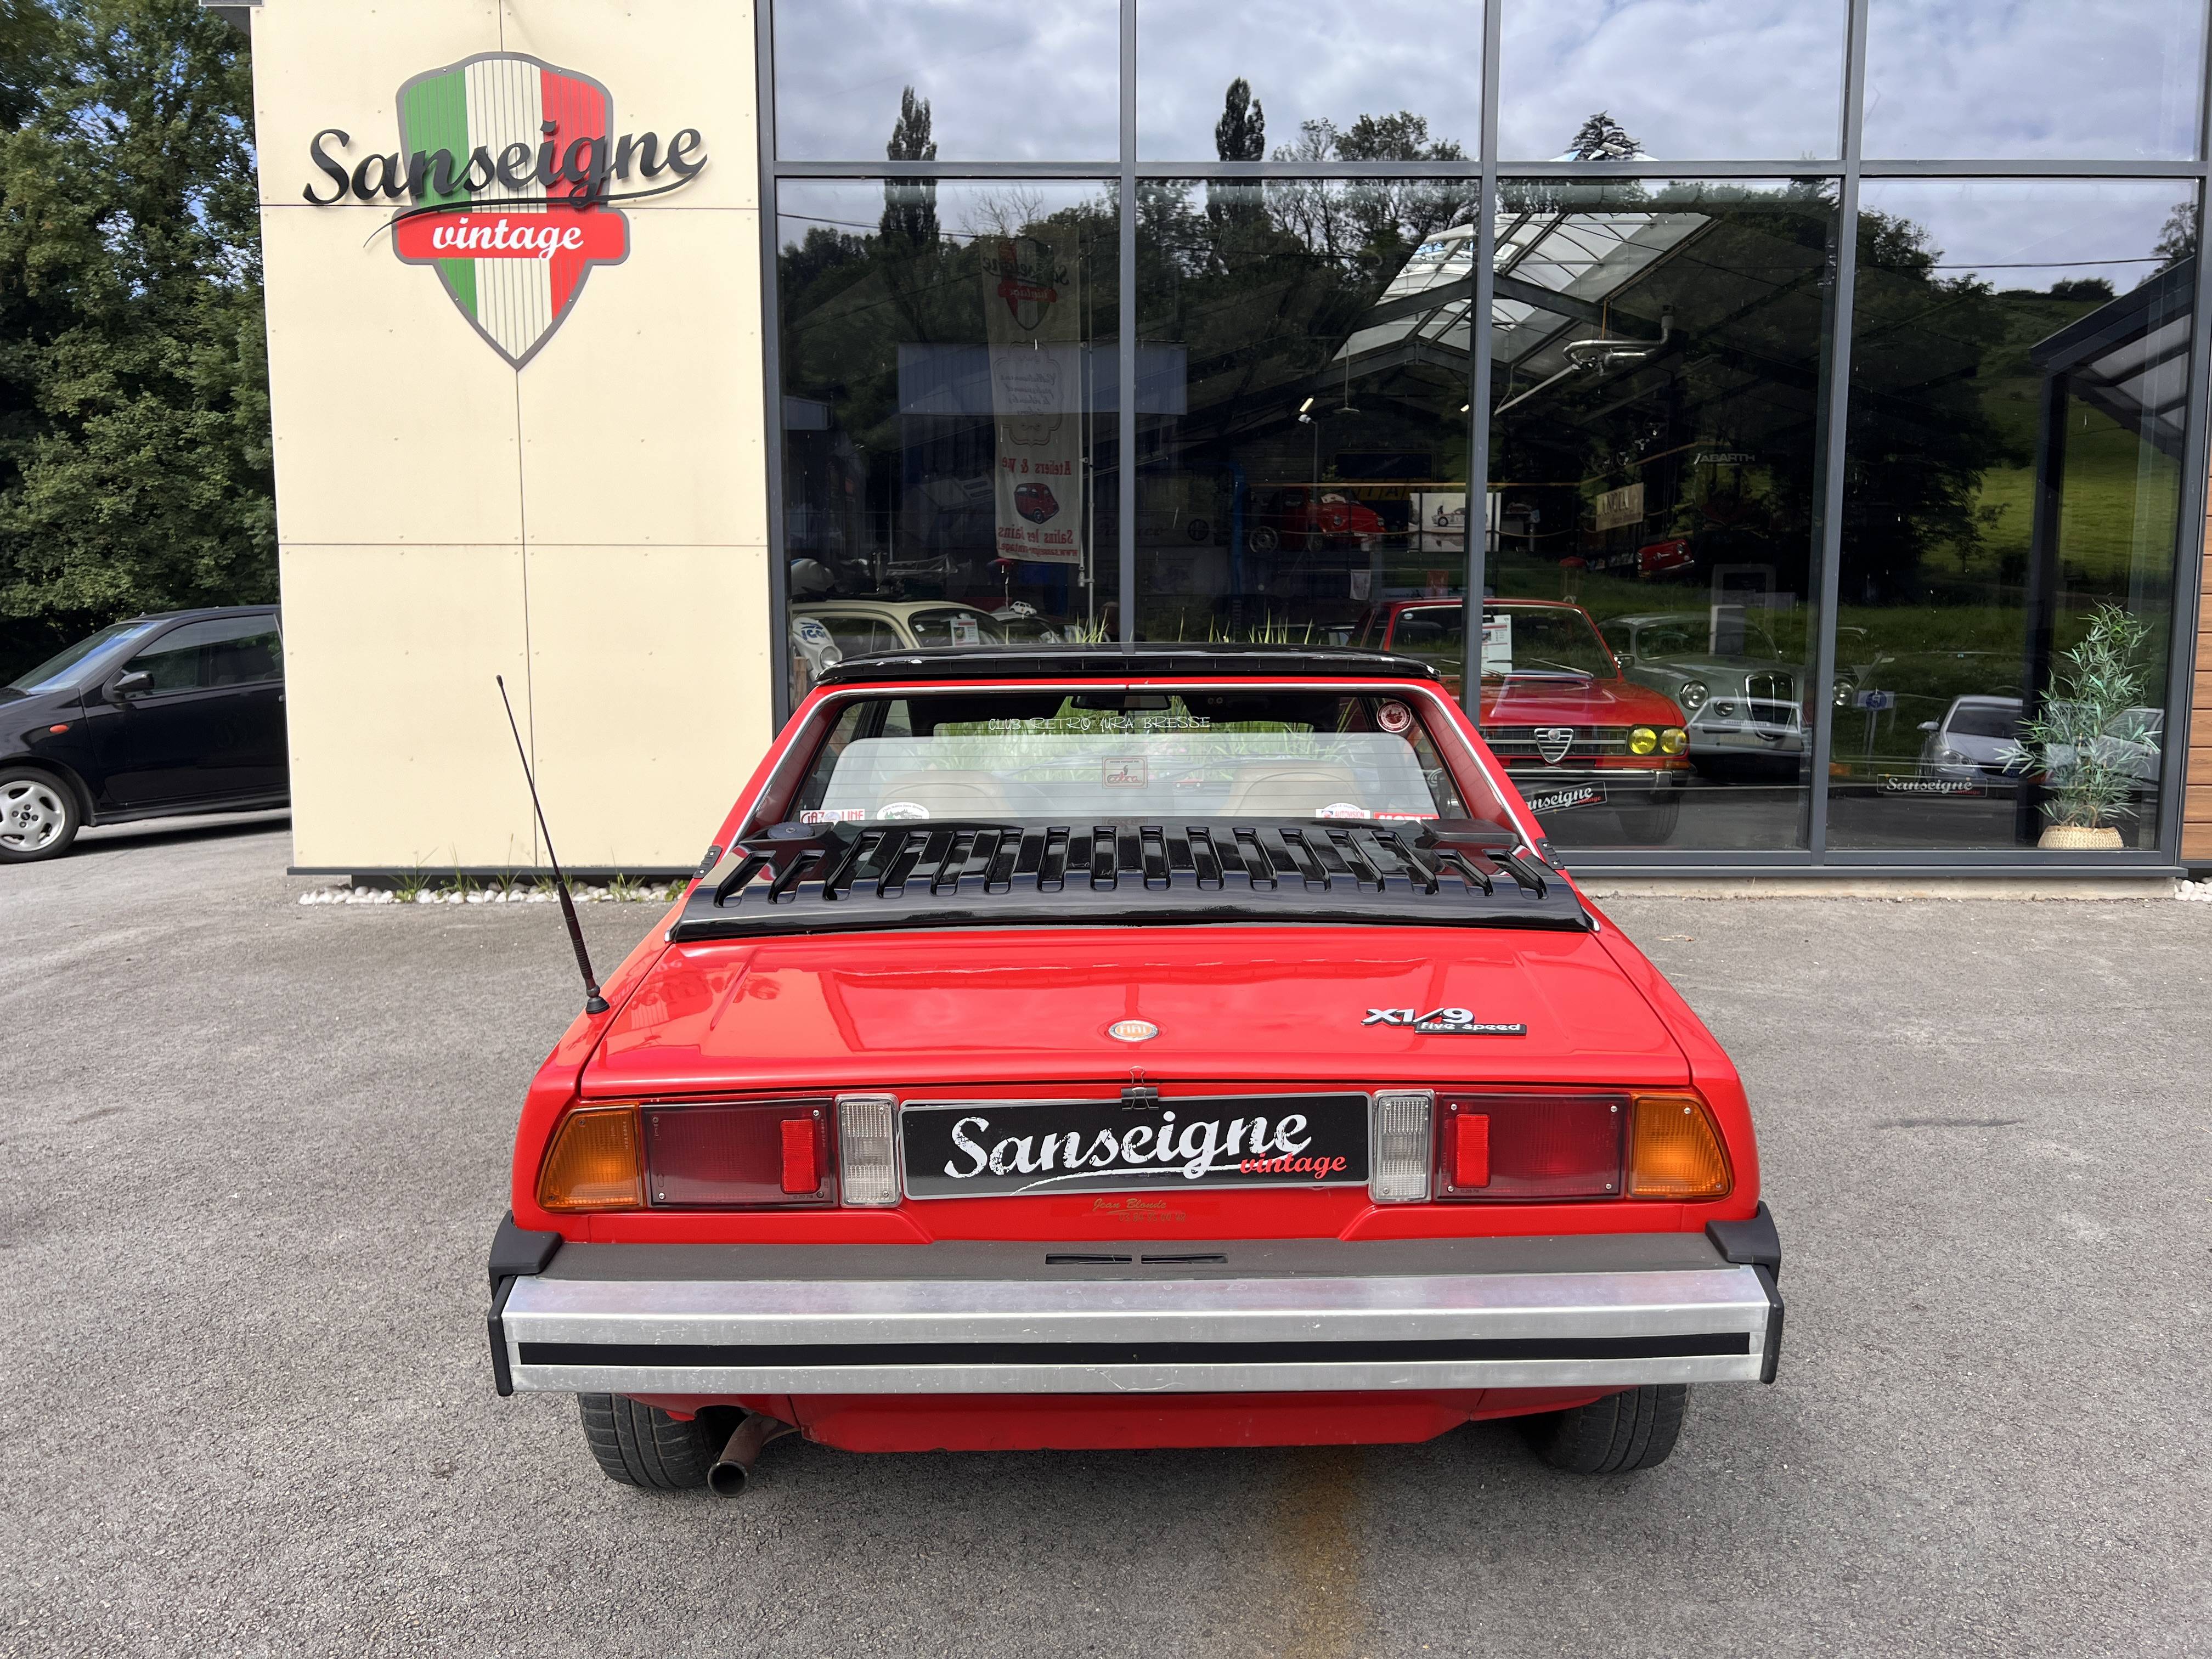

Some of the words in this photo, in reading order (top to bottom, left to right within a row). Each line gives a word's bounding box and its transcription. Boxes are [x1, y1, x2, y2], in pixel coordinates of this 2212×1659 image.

[302, 120, 708, 208] Sanseigne
[432, 216, 584, 259] vintage
[1699, 453, 1756, 462] ABARTH
[988, 718, 1022, 730] CLUB
[1031, 716, 1091, 731] RETRO
[1142, 716, 1211, 730] BRESSE
[1886, 777, 1974, 794] Sanseigne
[1361, 1007, 1475, 1026] X1/9
[1120, 1025, 1147, 1034] FIAT
[1420, 1022, 1455, 1030] five
[1462, 1023, 1520, 1031] speed
[945, 1109, 1313, 1180] Sanseigne
[1240, 1151, 1348, 1180] vintage
[1092, 1198, 1120, 1212] Jean
